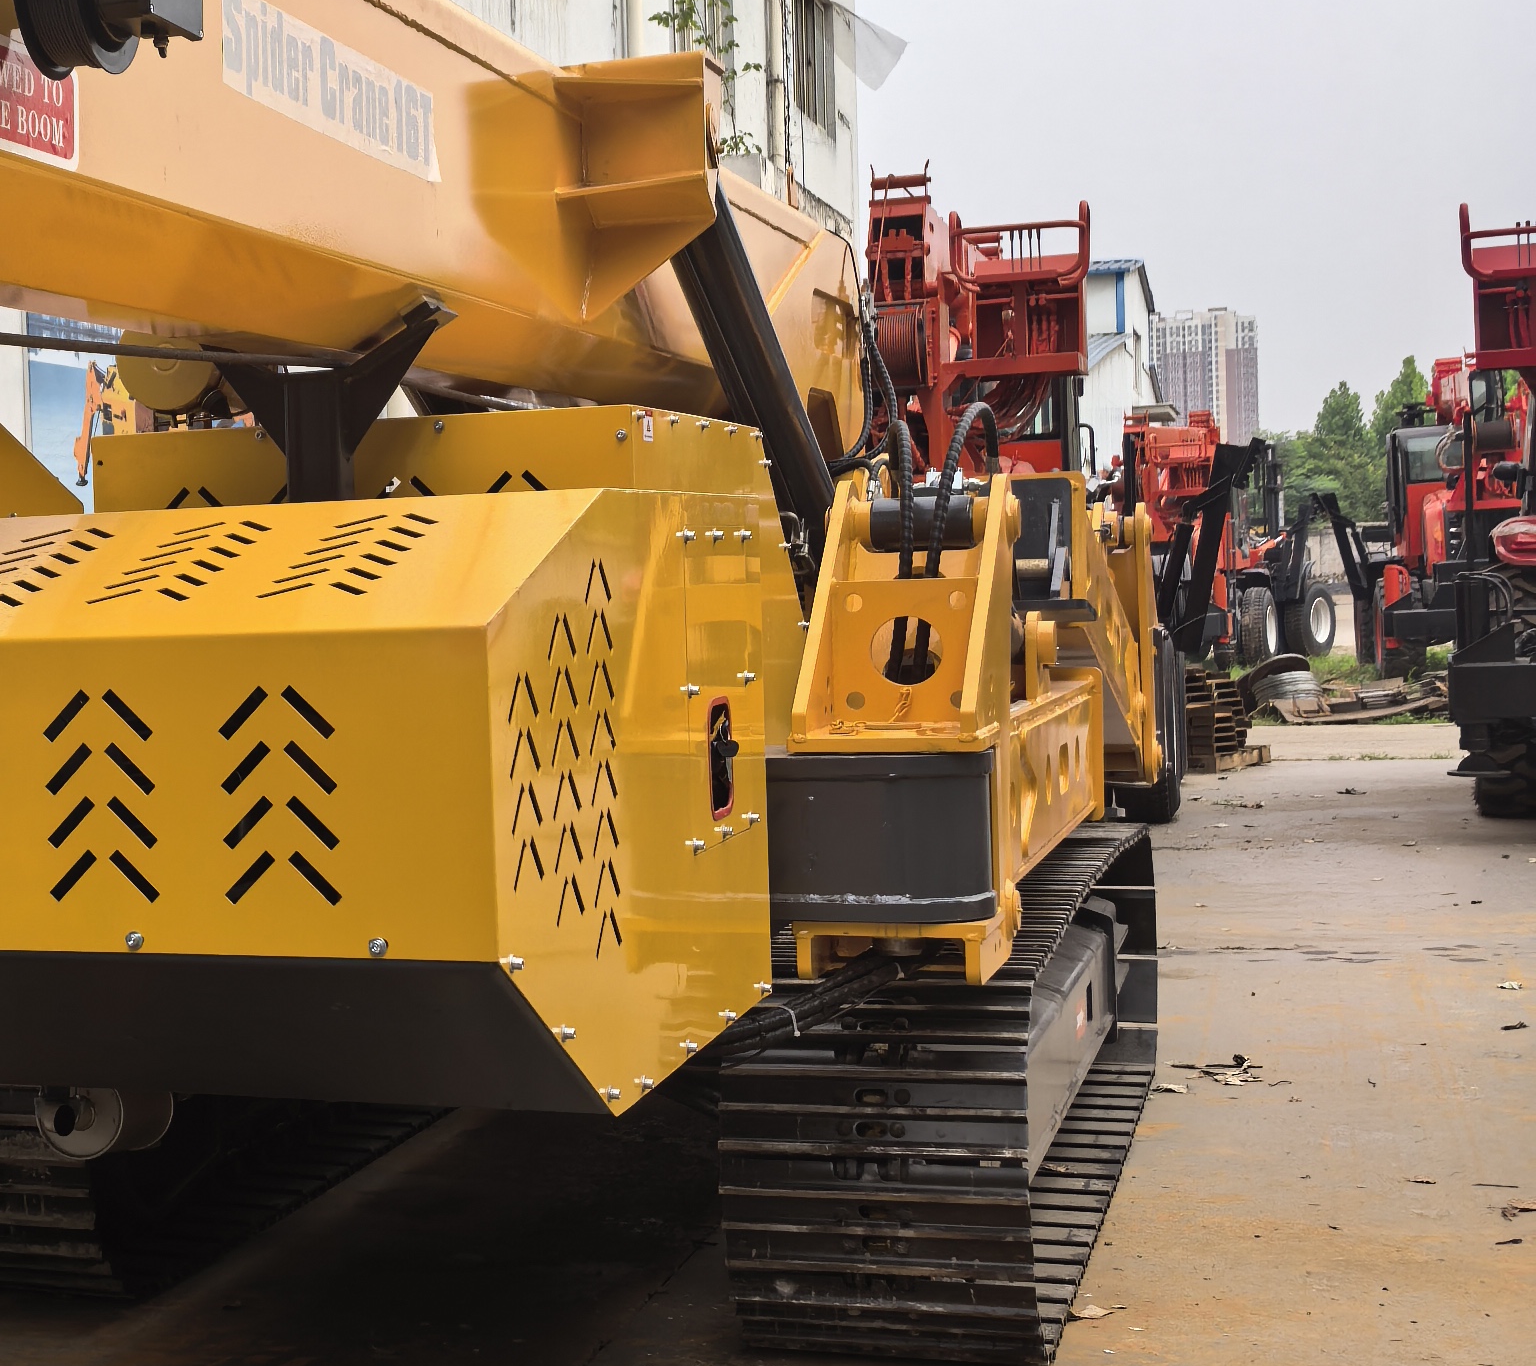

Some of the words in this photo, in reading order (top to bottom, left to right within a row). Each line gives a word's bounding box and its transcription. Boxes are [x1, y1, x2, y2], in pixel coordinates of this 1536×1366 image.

[41, 75, 64, 107] TO
[319, 36, 390, 146] Crane
[394, 79, 432, 167] 16T
[17, 105, 65, 148] BOOM
